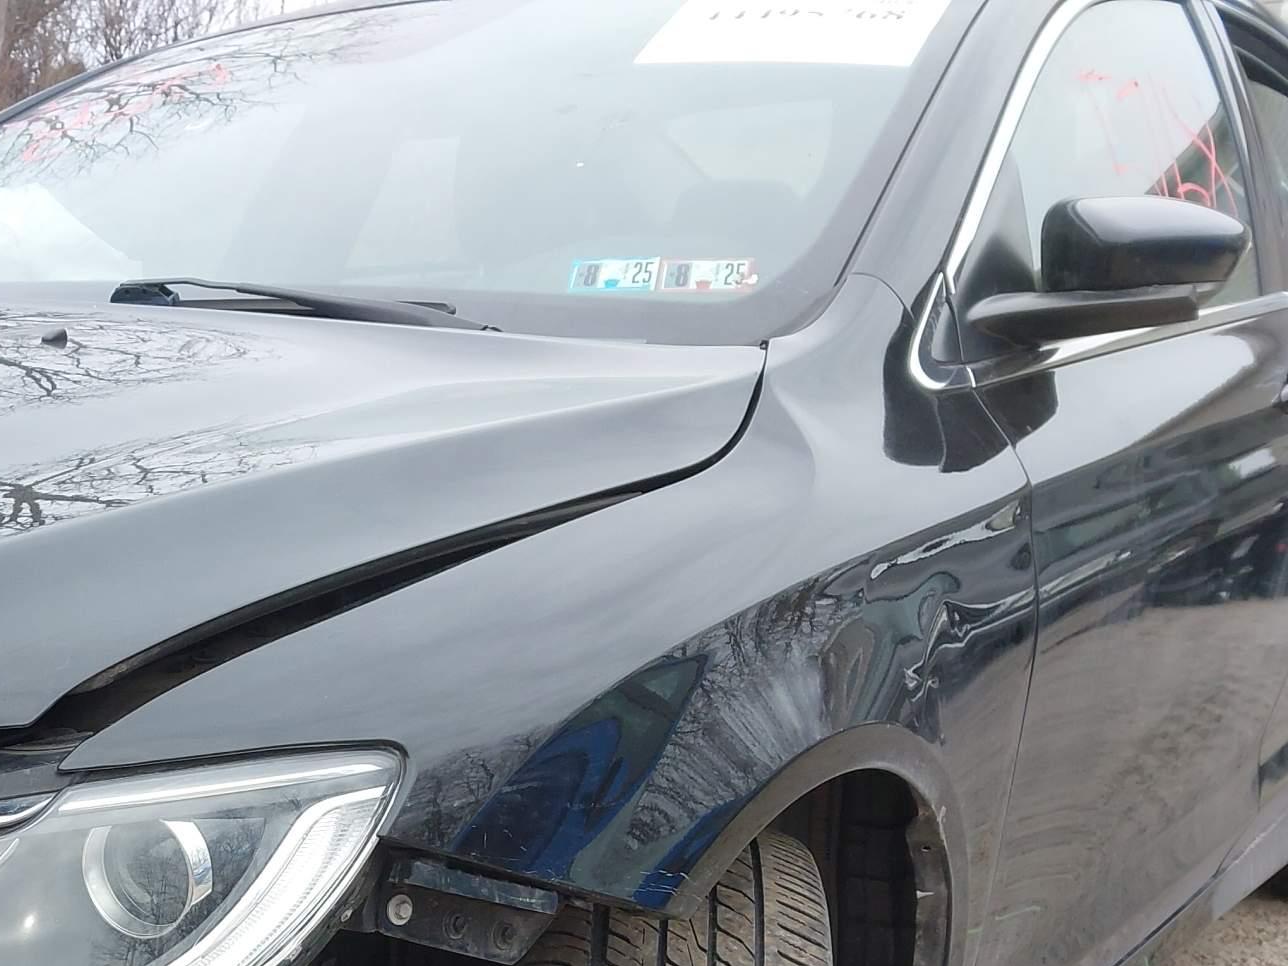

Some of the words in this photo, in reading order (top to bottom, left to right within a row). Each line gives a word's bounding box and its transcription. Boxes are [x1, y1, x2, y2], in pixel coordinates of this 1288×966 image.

[583, 263, 600, 287] 8
[631, 261, 654, 284] 25
[674, 263, 691, 287] 8
[723, 262, 746, 286] 25
